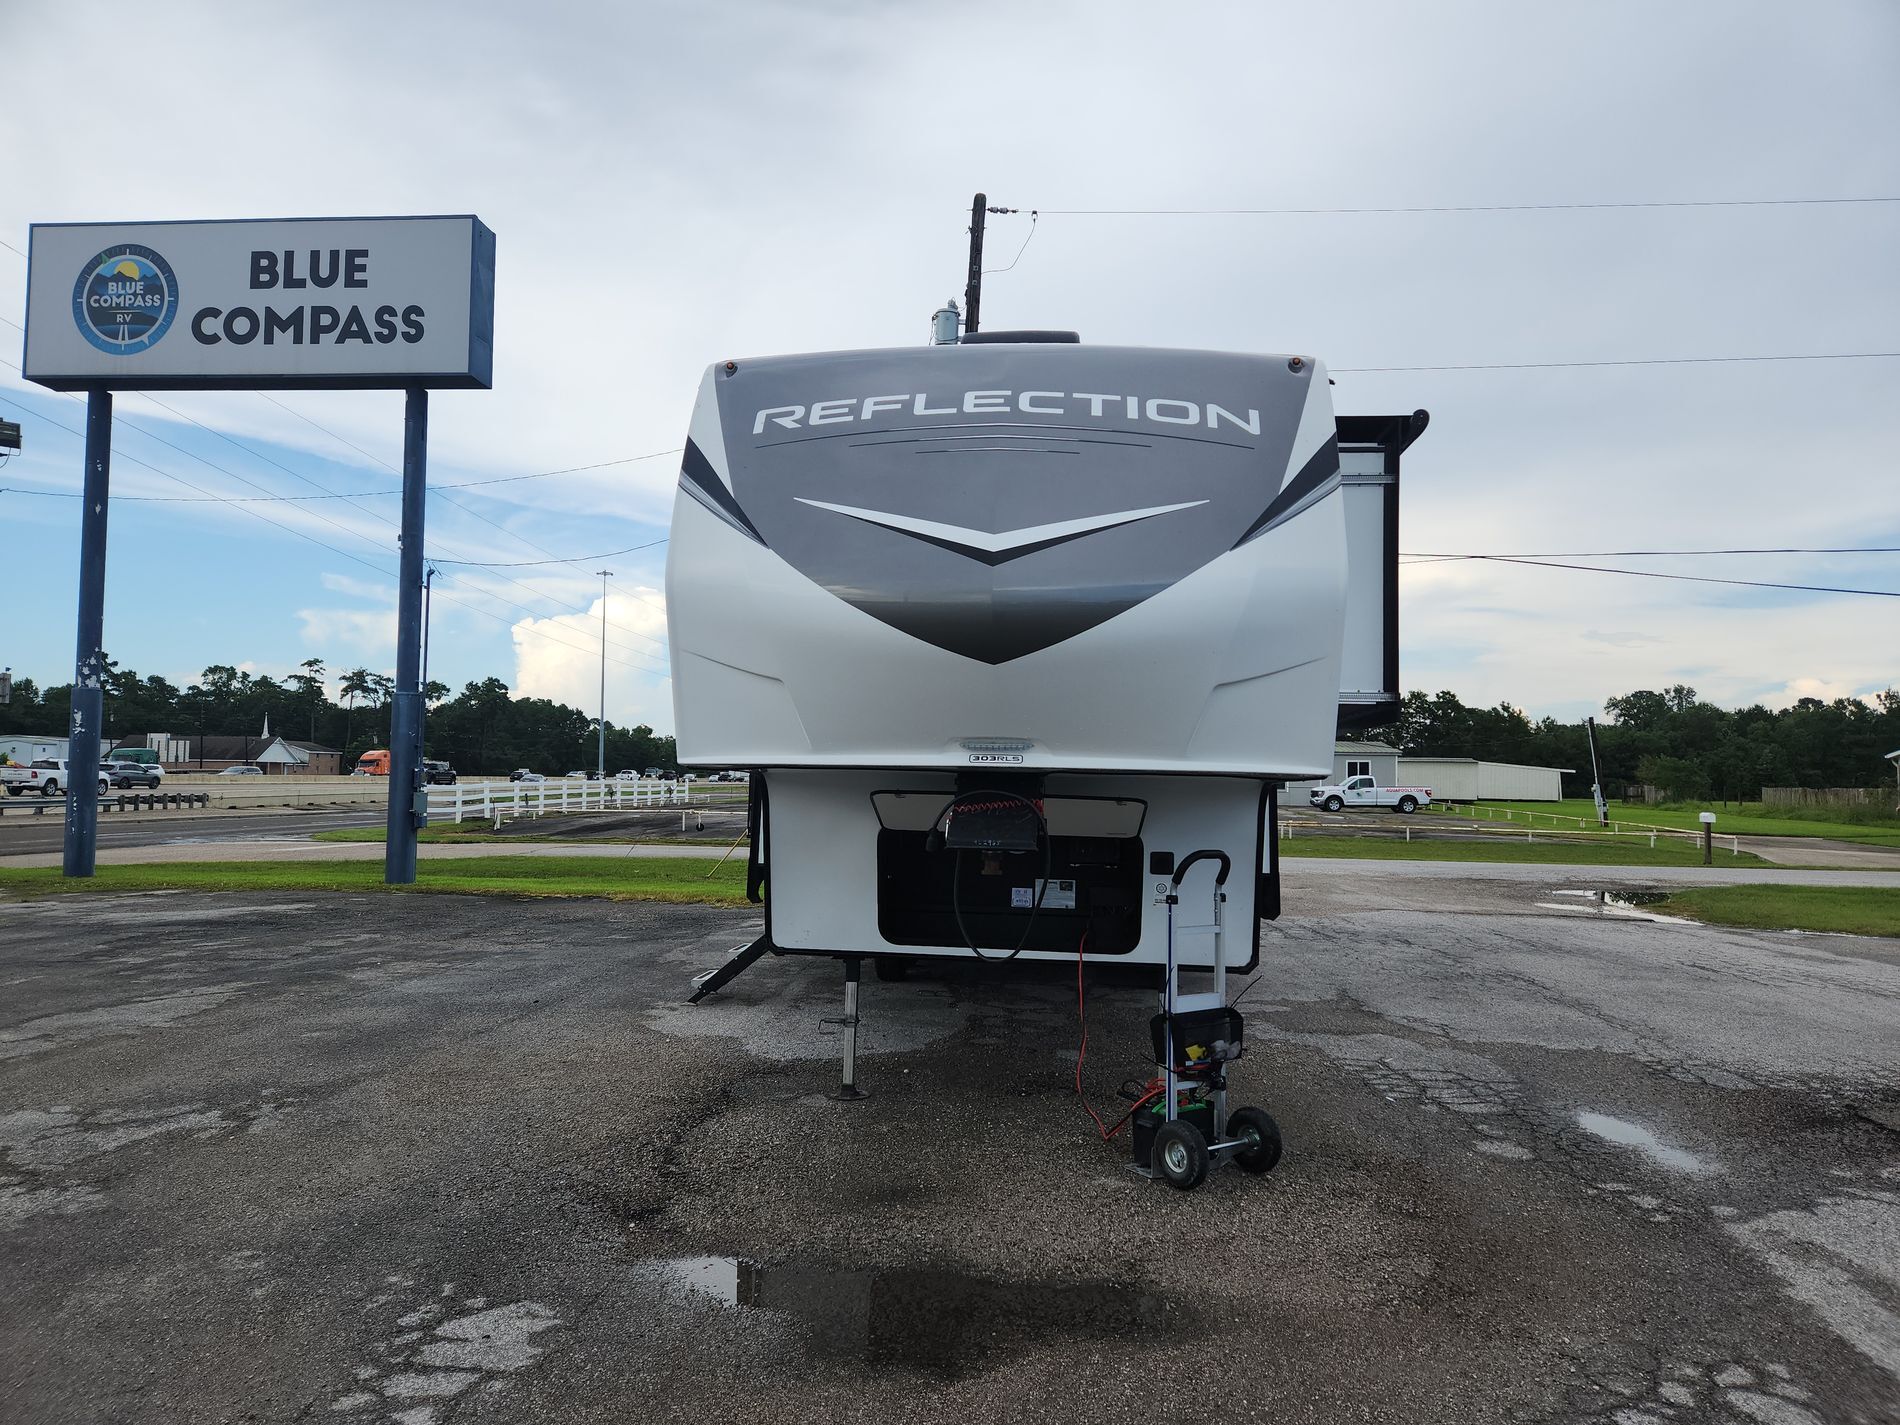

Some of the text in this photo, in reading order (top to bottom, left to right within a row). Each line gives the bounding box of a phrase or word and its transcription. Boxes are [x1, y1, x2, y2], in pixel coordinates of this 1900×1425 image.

[249, 249, 369, 289] BLUE
[90, 294, 161, 307] COMPASS
[108, 282, 144, 294] BLUE
[116, 314, 132, 323] RV
[191, 304, 425, 345] COMPASS
[752, 390, 1261, 435] REFLECTION
